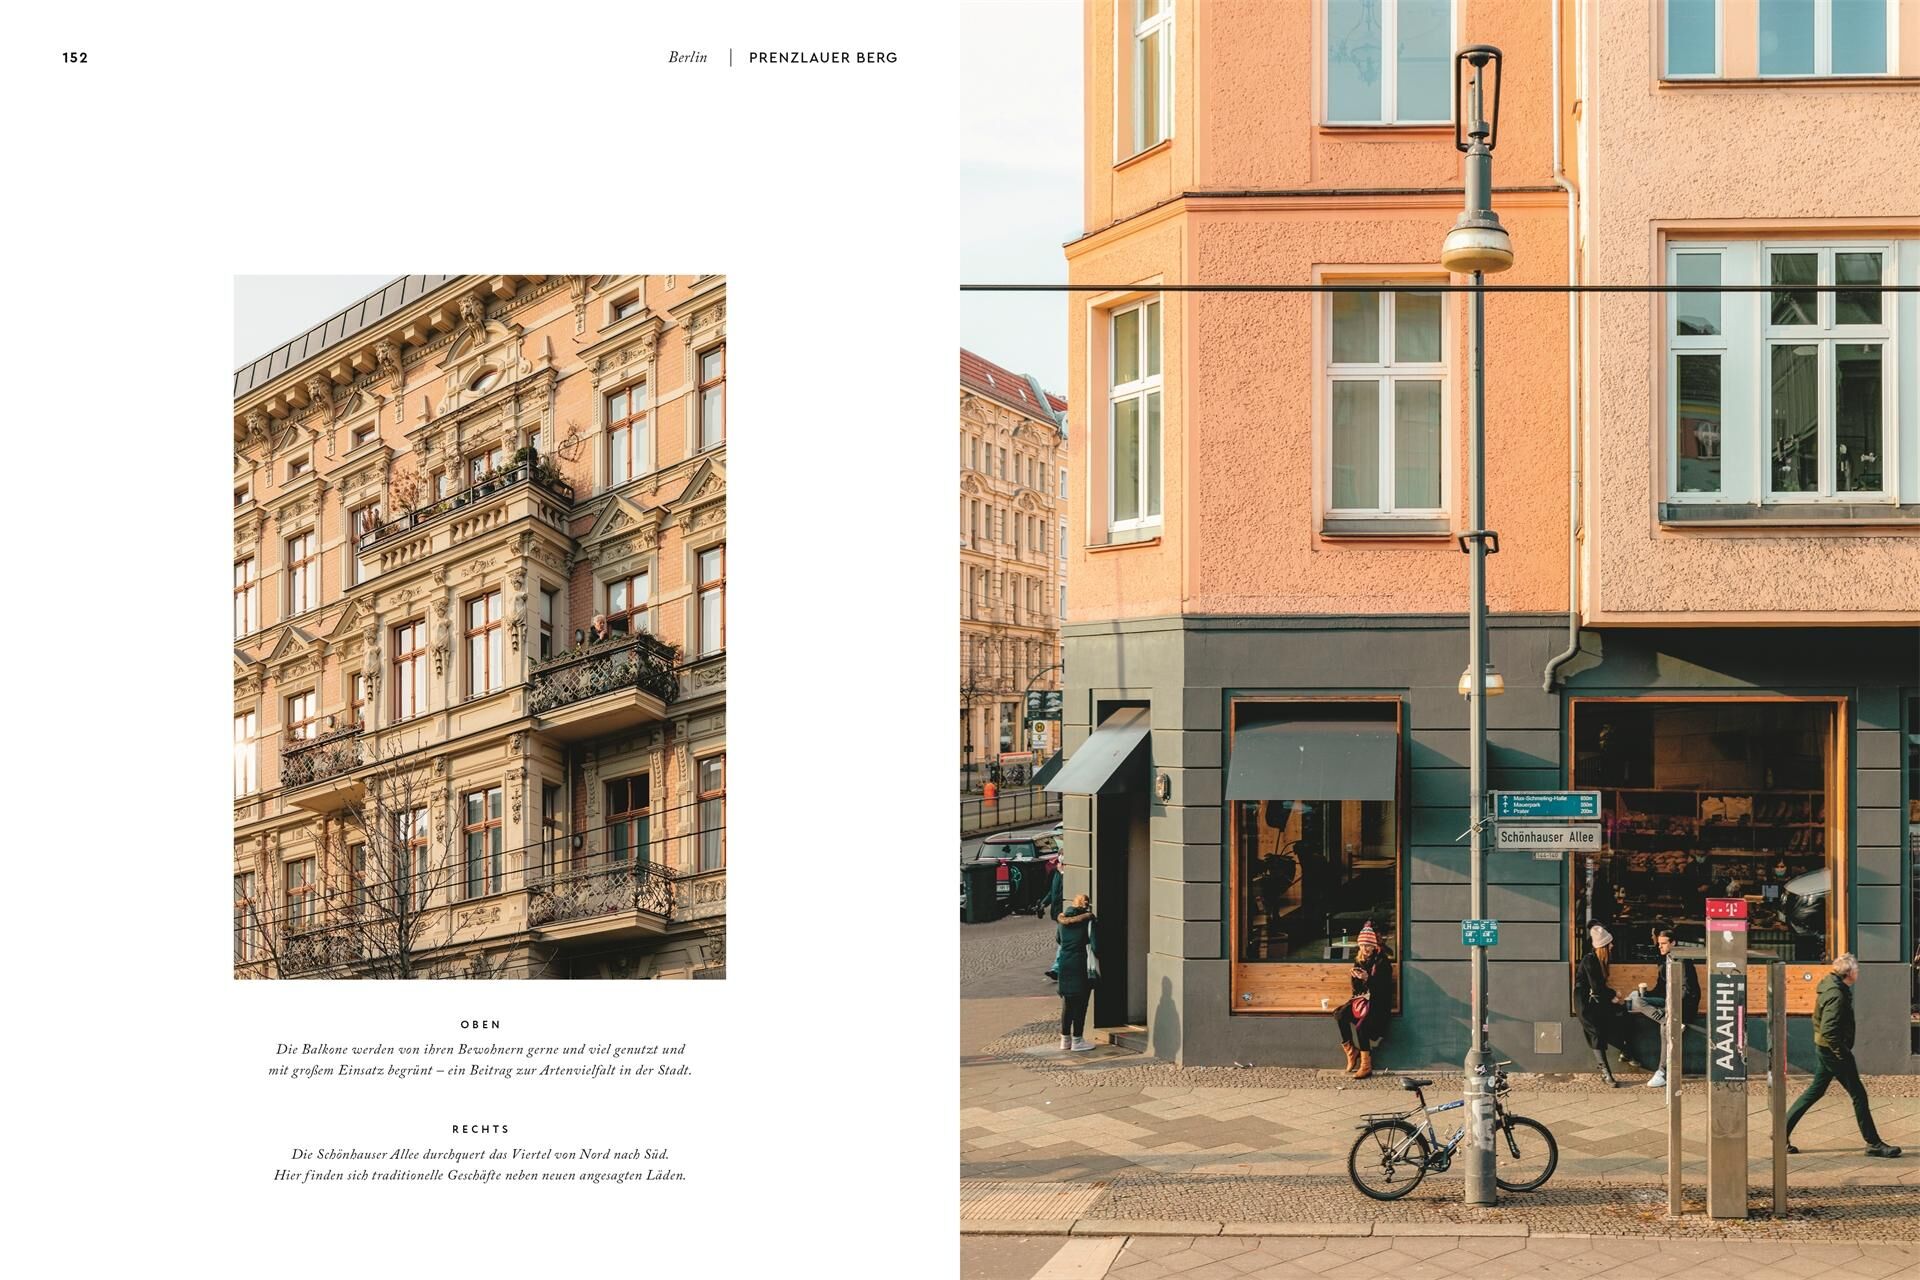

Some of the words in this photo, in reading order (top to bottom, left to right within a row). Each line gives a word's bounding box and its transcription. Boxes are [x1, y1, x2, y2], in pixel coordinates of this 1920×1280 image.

[1501, 831, 1564, 843] Schönhauser
[1569, 831, 1594, 843] Allee
[1716, 982, 1735, 1071] AAAHH!
